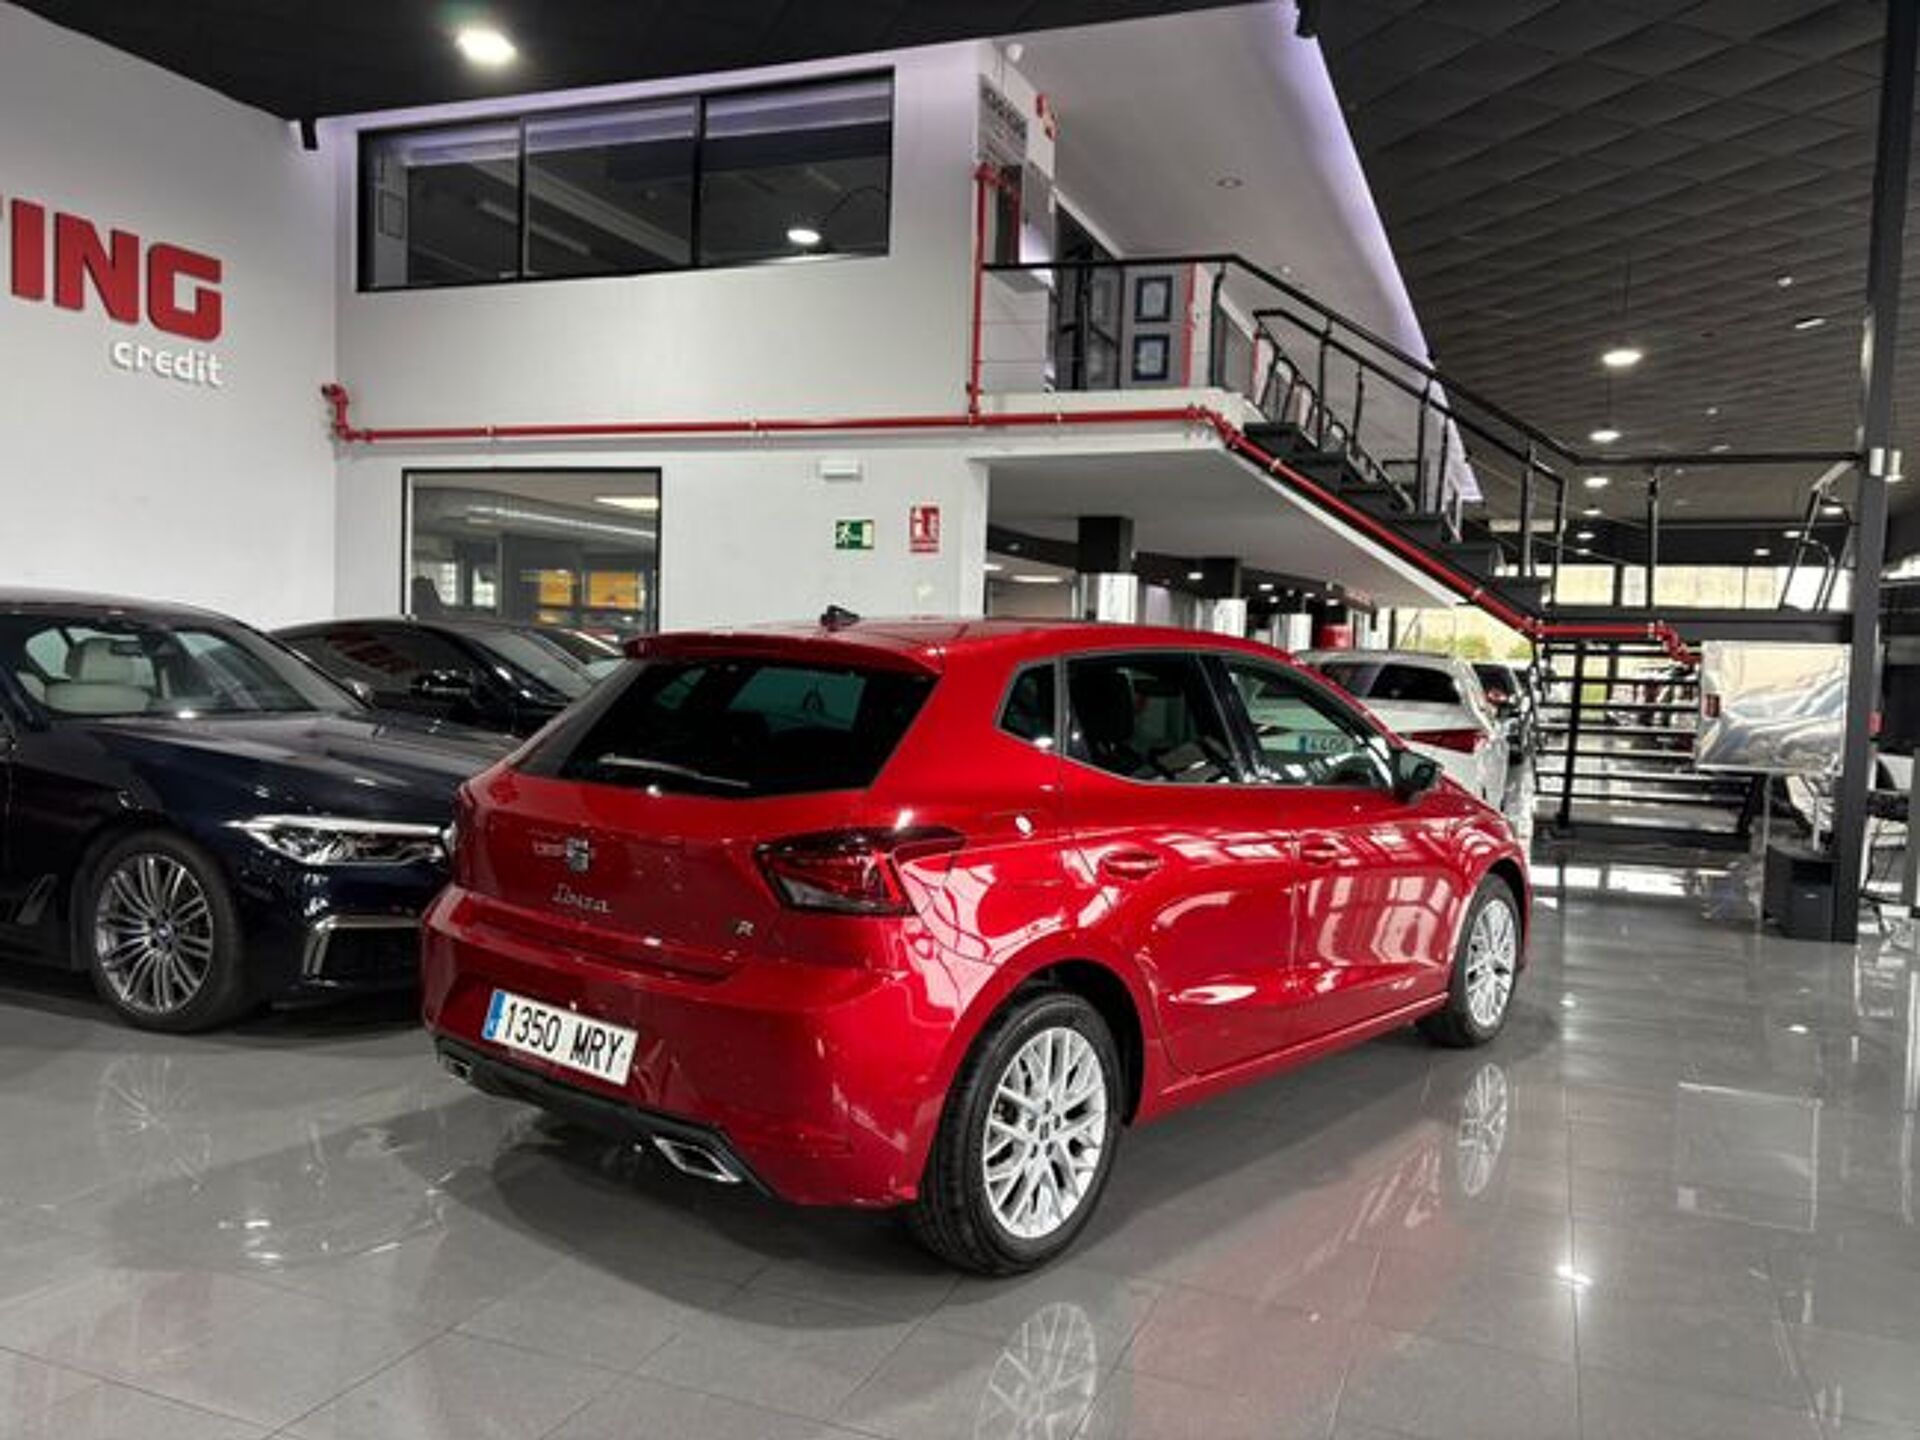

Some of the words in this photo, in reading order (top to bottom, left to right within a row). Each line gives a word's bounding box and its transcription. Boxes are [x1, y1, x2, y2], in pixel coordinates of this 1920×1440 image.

[0, 196, 222, 342] ING
[112, 341, 224, 386] credit
[504, 1002, 562, 1053] 1350
[569, 1022, 625, 1074] MRY
